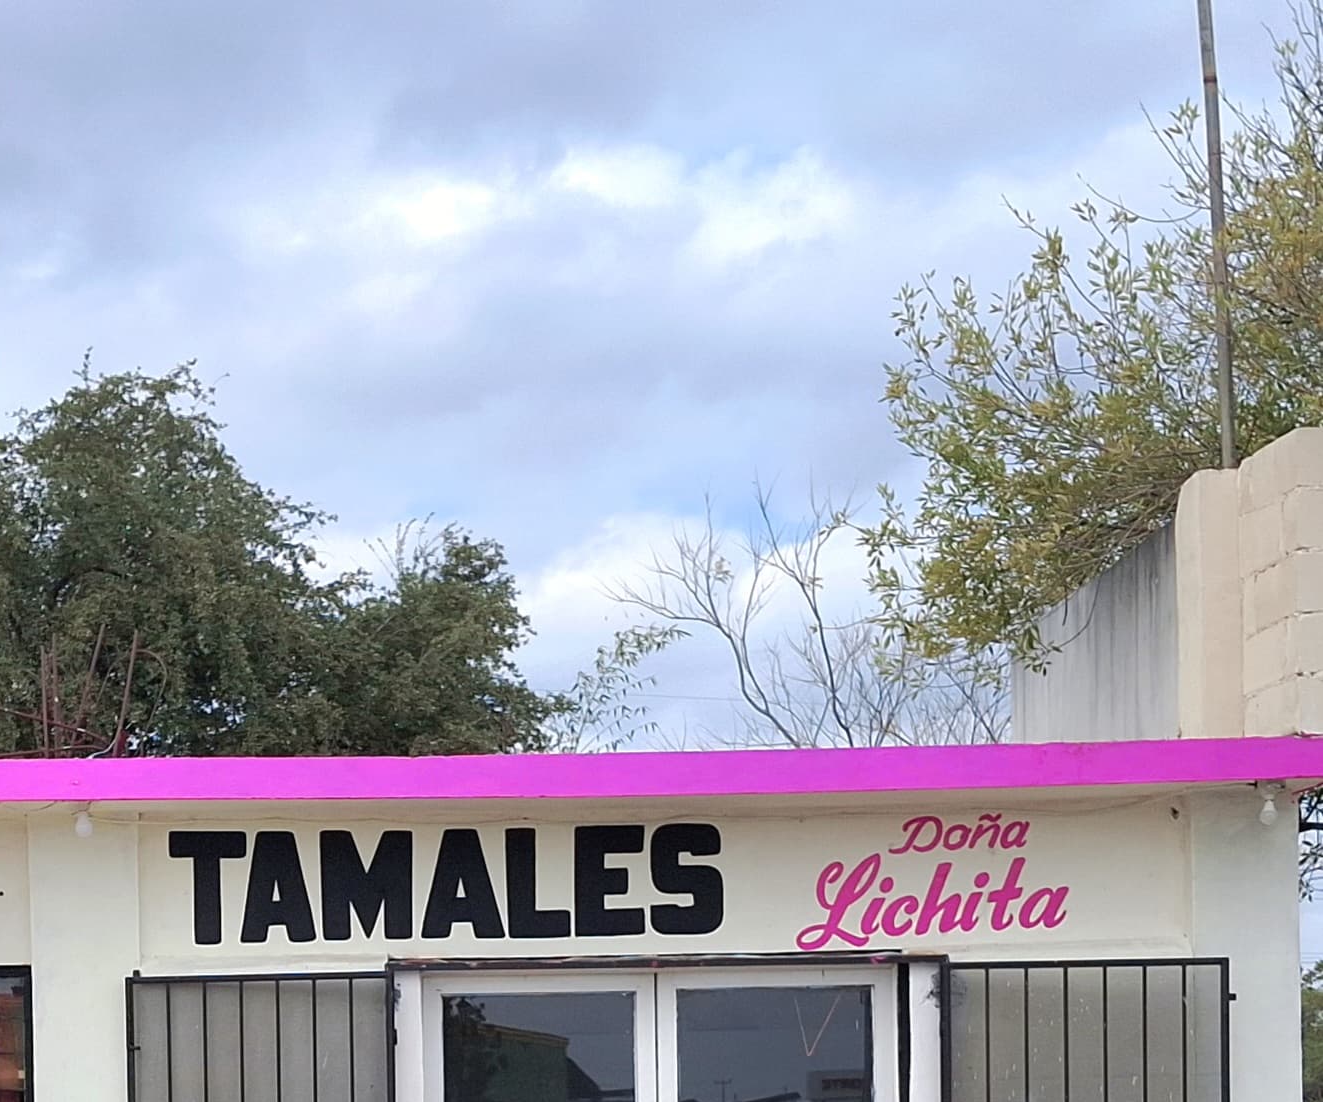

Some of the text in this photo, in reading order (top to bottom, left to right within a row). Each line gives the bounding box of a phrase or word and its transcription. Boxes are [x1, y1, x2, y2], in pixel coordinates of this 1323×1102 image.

[168, 822, 724, 945] TAMALES
[888, 813, 1031, 855] Doña
[795, 853, 1070, 952] Lichita
